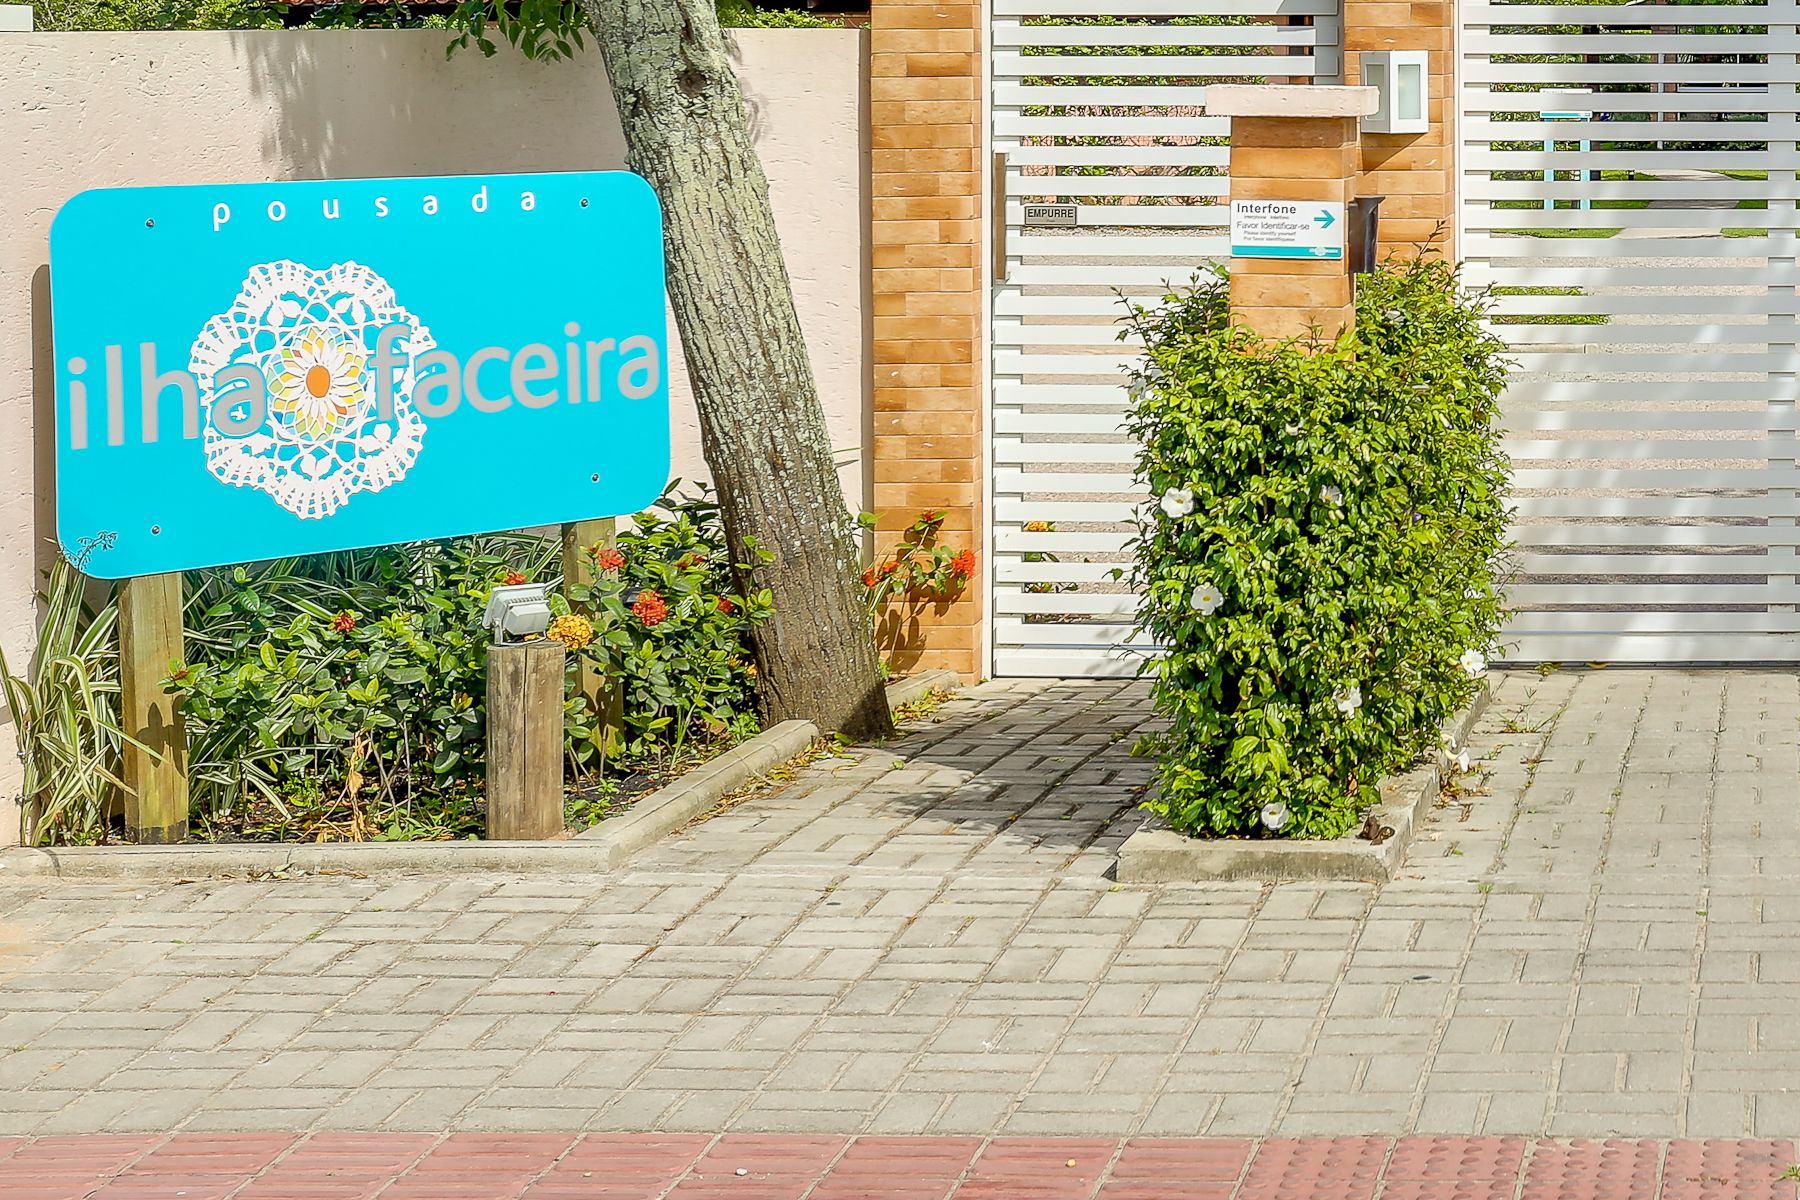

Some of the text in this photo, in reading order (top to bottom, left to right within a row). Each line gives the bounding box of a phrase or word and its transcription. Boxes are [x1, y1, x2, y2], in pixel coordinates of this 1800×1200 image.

[213, 185, 536, 231] pousada
[1027, 209, 1074, 218] EMPURRE
[1237, 203, 1296, 214] Interfone
[1236, 221, 1310, 230] Favor Identificar-se
[67, 321, 660, 450] ilha faceira
